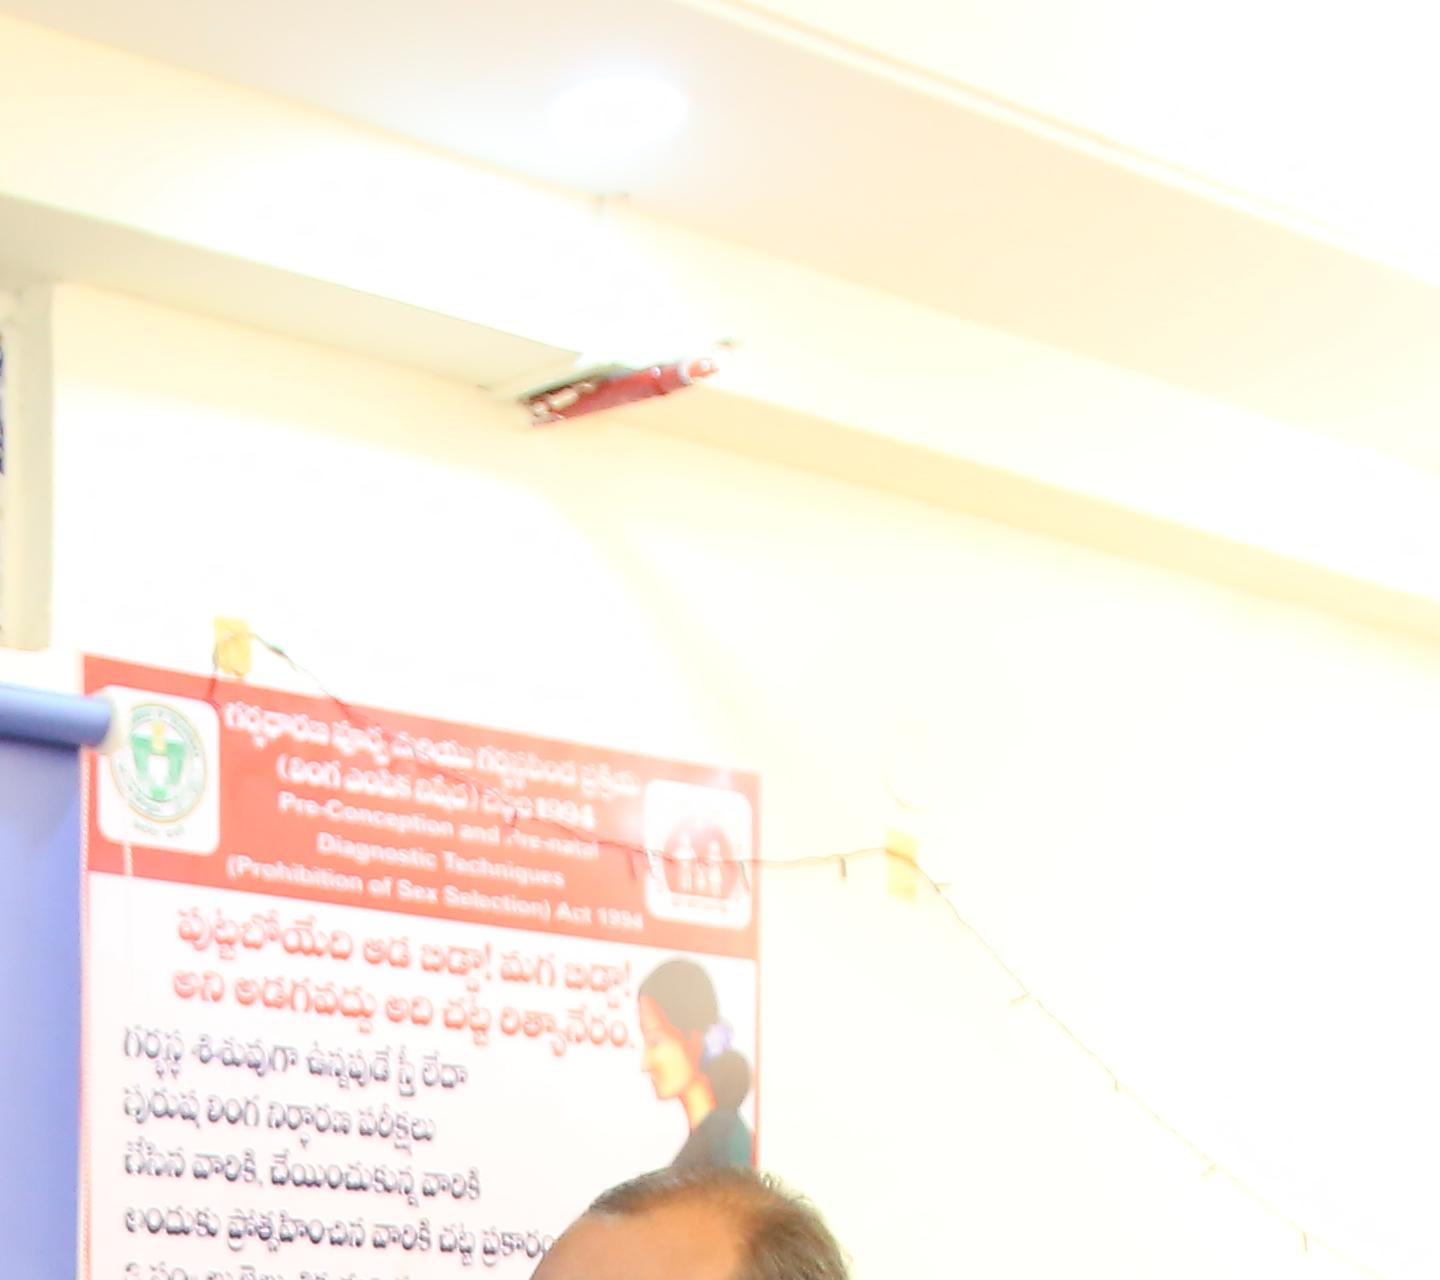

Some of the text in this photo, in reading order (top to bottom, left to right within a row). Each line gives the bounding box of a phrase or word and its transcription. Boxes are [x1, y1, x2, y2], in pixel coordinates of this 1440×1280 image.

[278, 792, 453, 837] Pre-Conception
[459, 819, 499, 843] and
[318, 832, 564, 887] Diagnostic Techniques
[227, 854, 644, 931] (Prohibition of Sex Selection) Act 1994
